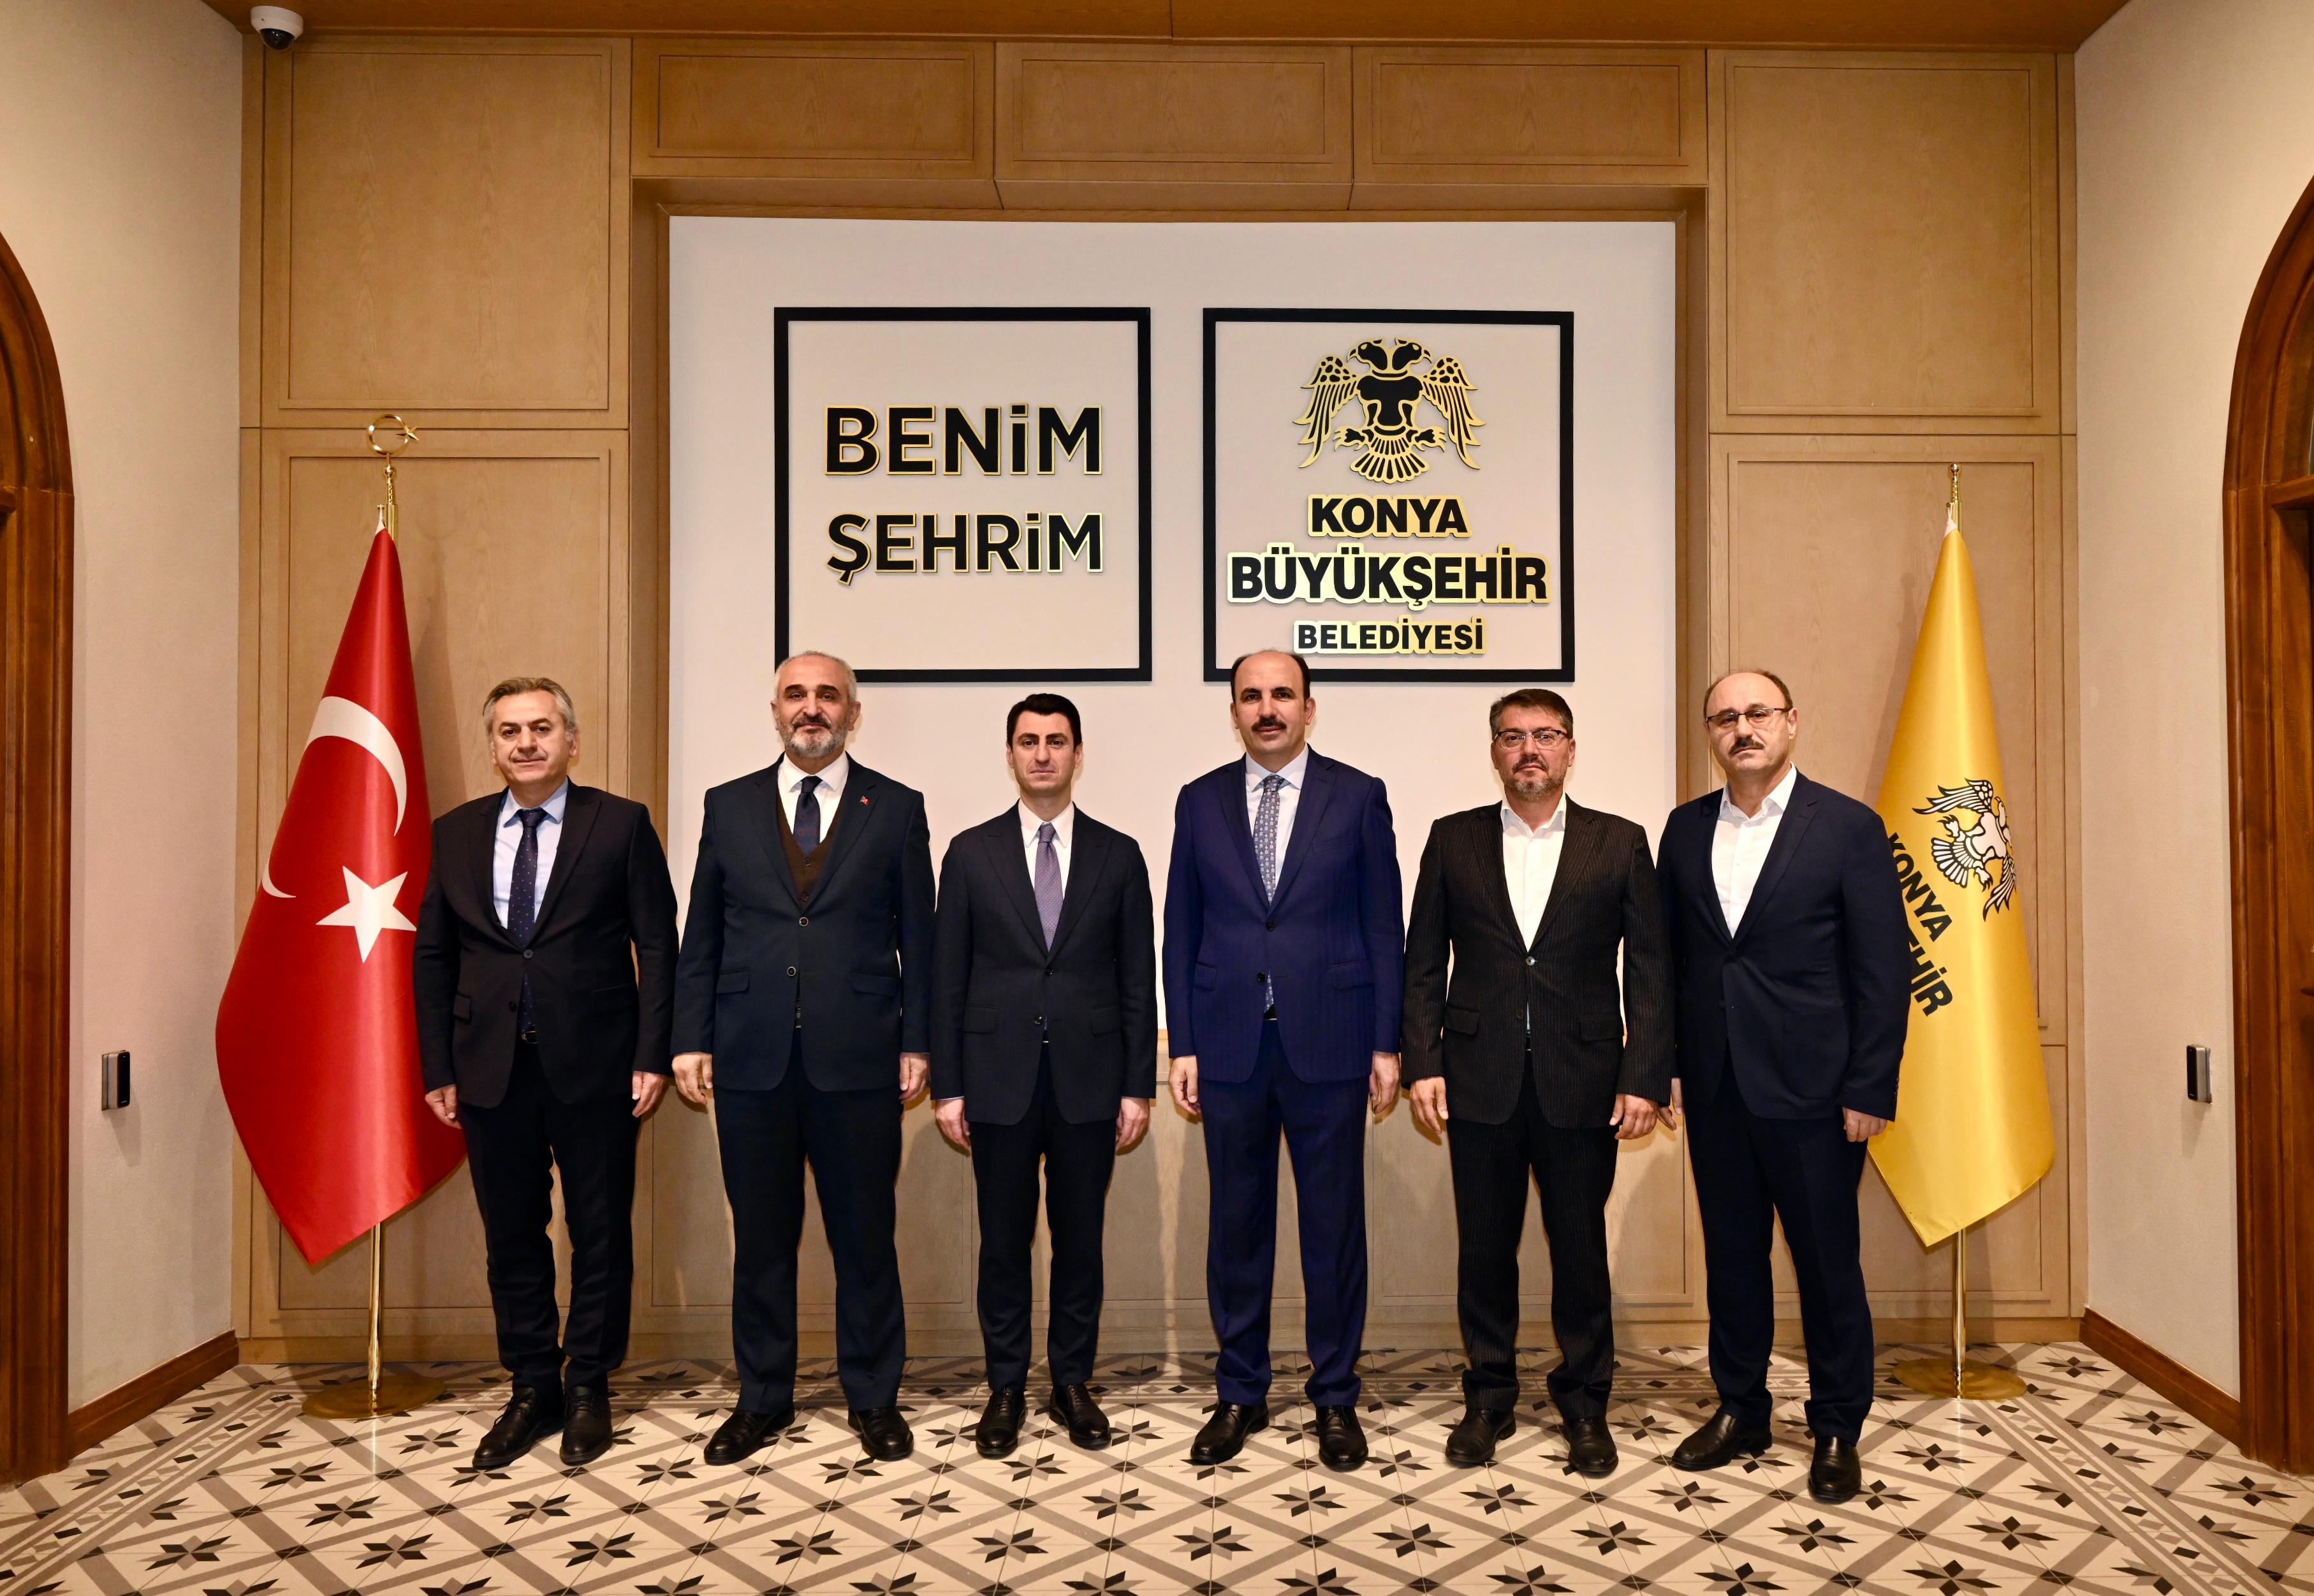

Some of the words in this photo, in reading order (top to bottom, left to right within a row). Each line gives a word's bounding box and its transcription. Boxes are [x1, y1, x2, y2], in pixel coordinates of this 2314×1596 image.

[1311, 497, 1469, 534] KONYA
[1231, 546, 1548, 608] BÜYÜKŞEHİR
[1298, 617, 1484, 651] BELEDİYESİ
[1888, 831, 1952, 942] KONYA
